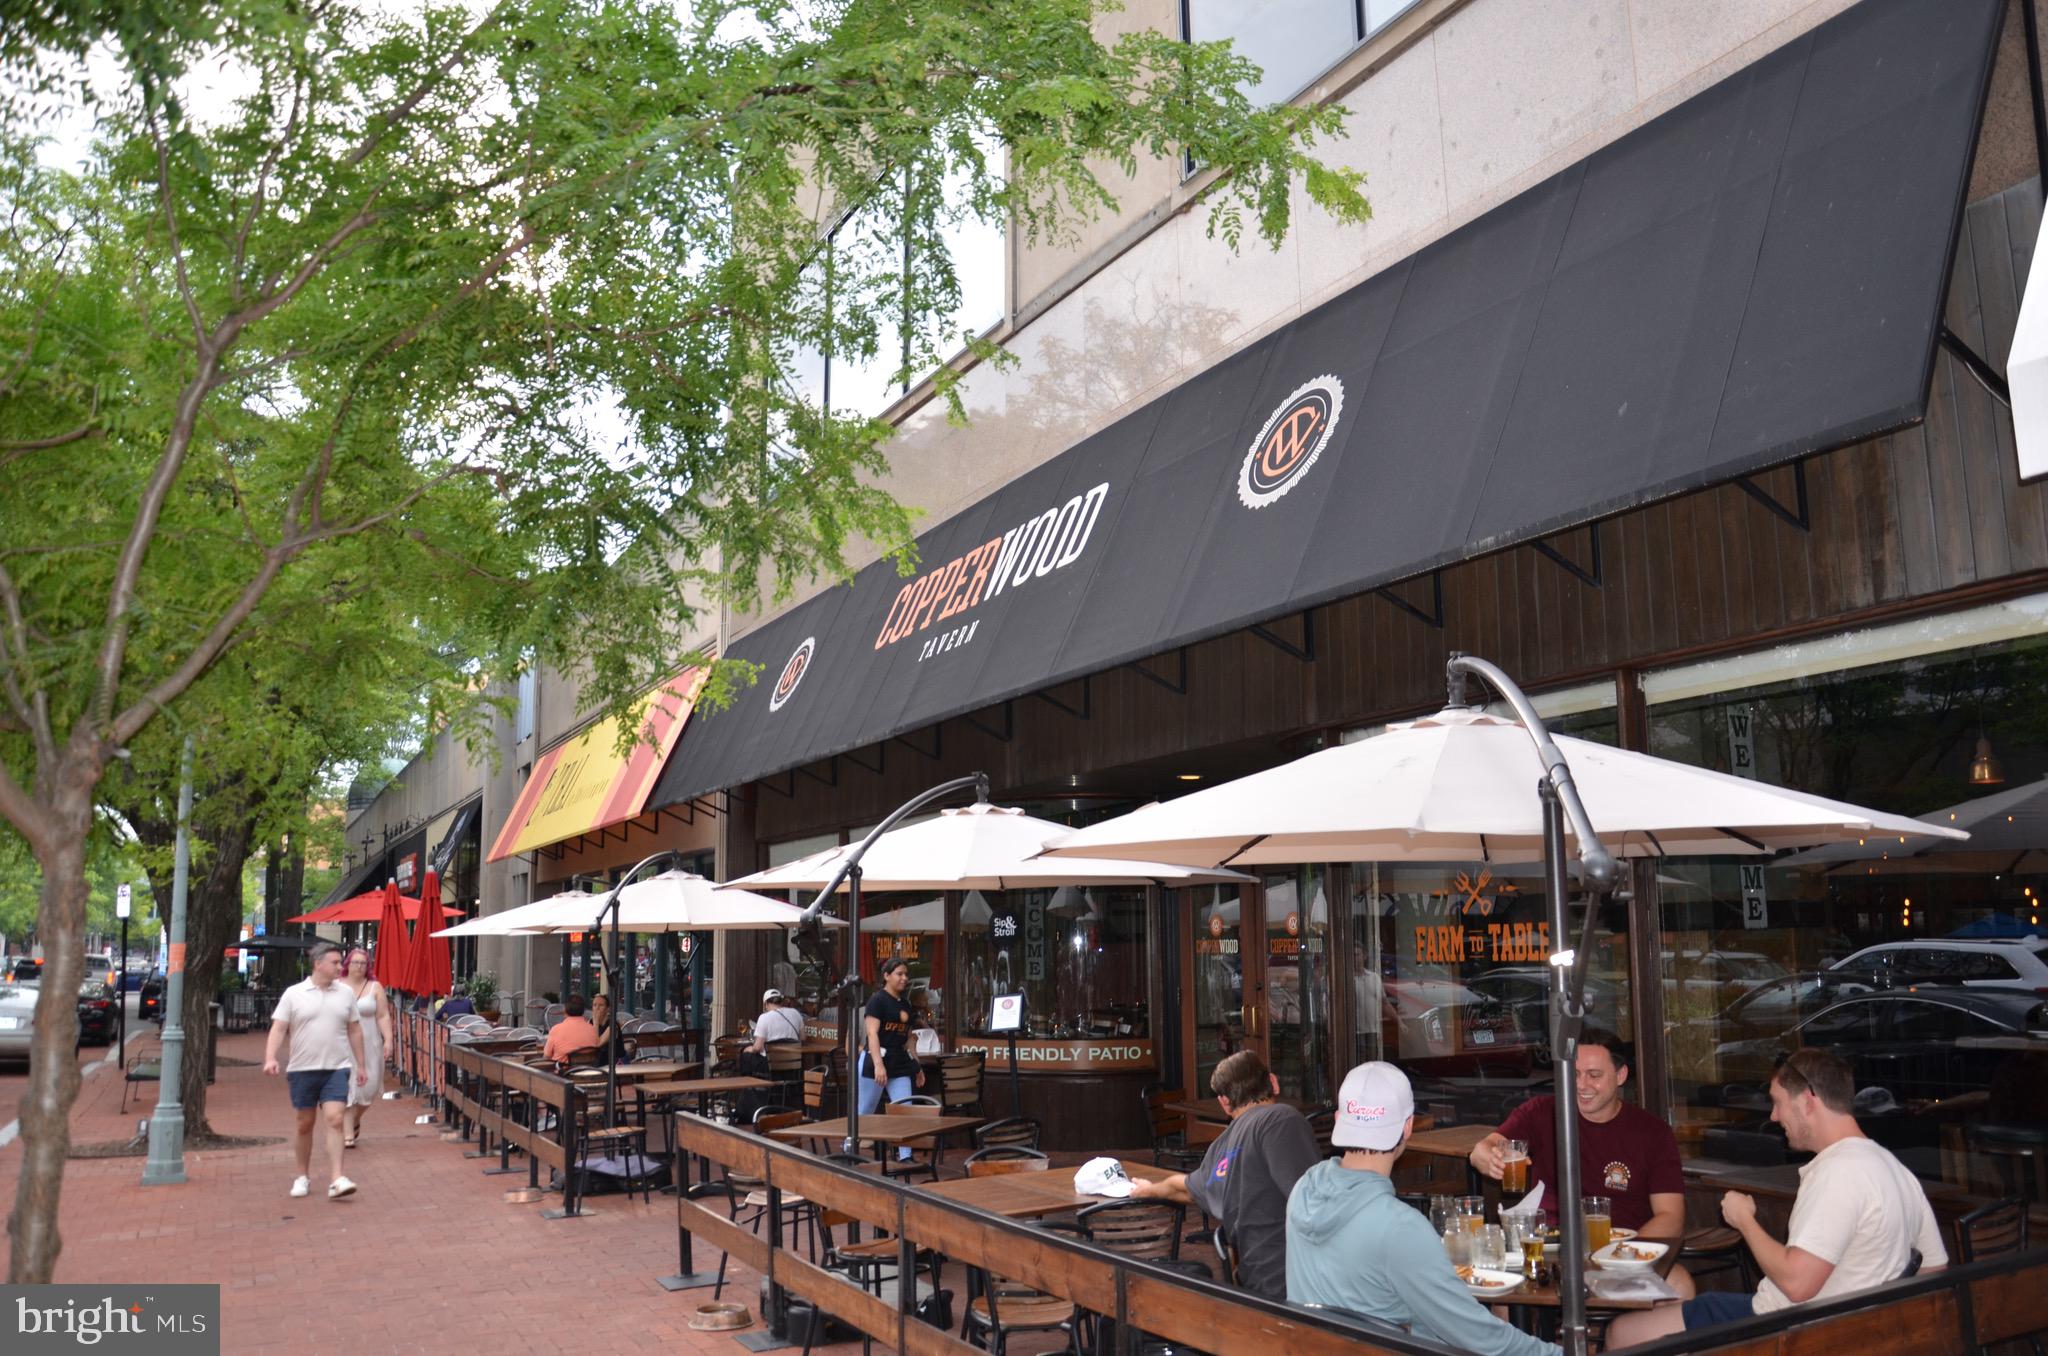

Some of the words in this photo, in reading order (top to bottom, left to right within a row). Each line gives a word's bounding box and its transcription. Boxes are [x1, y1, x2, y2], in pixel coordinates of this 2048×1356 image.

[875, 482, 1109, 650] COPPERWOOD
[918, 620, 980, 662] TAVERN
[994, 927, 1015, 936] Stroll
[1415, 923, 1465, 962] FARM
[1469, 935, 1484, 953] TO
[1488, 921, 1549, 962] TABLE
[1088, 1047, 1142, 1060] PATIO
